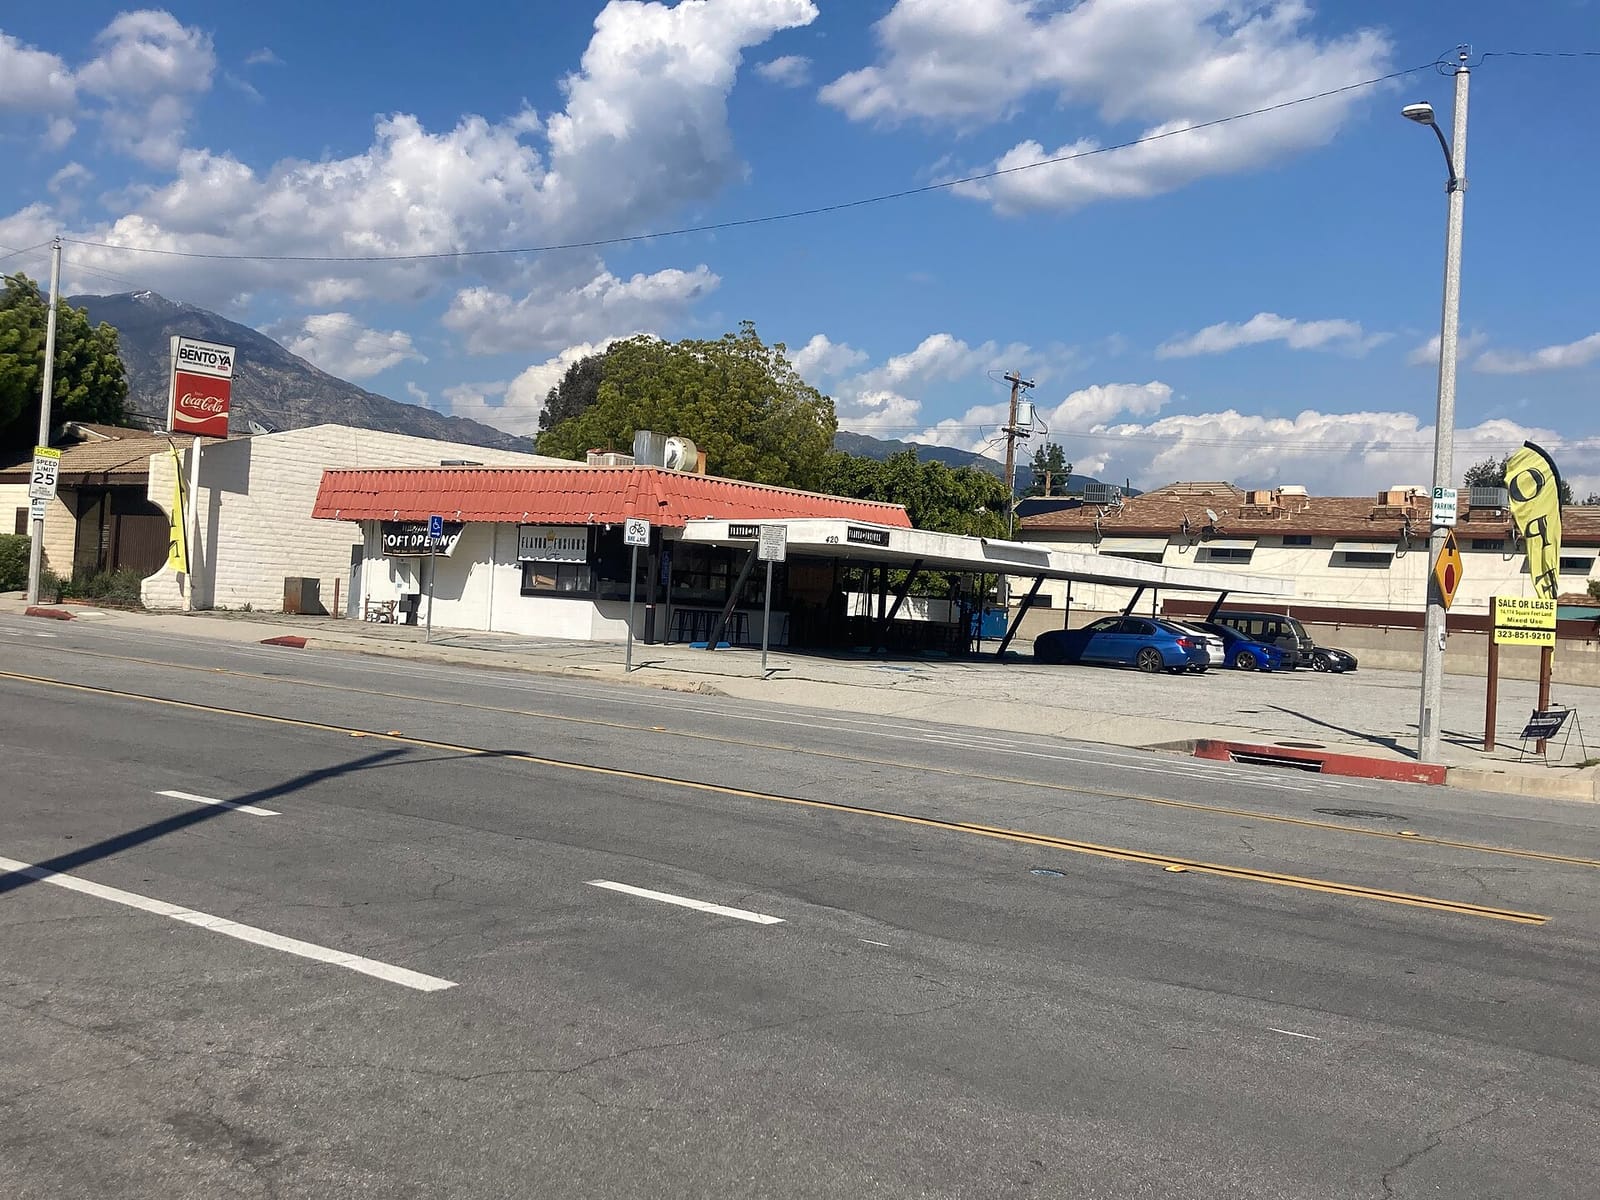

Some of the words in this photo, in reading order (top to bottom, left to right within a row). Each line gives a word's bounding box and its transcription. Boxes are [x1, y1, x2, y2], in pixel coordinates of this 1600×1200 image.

[36, 448, 60, 458] SCHOOL
[36, 458, 58, 468] SPEED
[36, 465, 55, 473] LIMIT
[33, 472, 55, 486] 25
[1434, 502, 1456, 511] PARKING
[826, 535, 839, 544] 420
[1498, 599, 1517, 608] SALE
[1518, 600, 1529, 609] OR
[1530, 601, 1555, 610] LEASE
[1497, 630, 1551, 640] 323-851-9210
